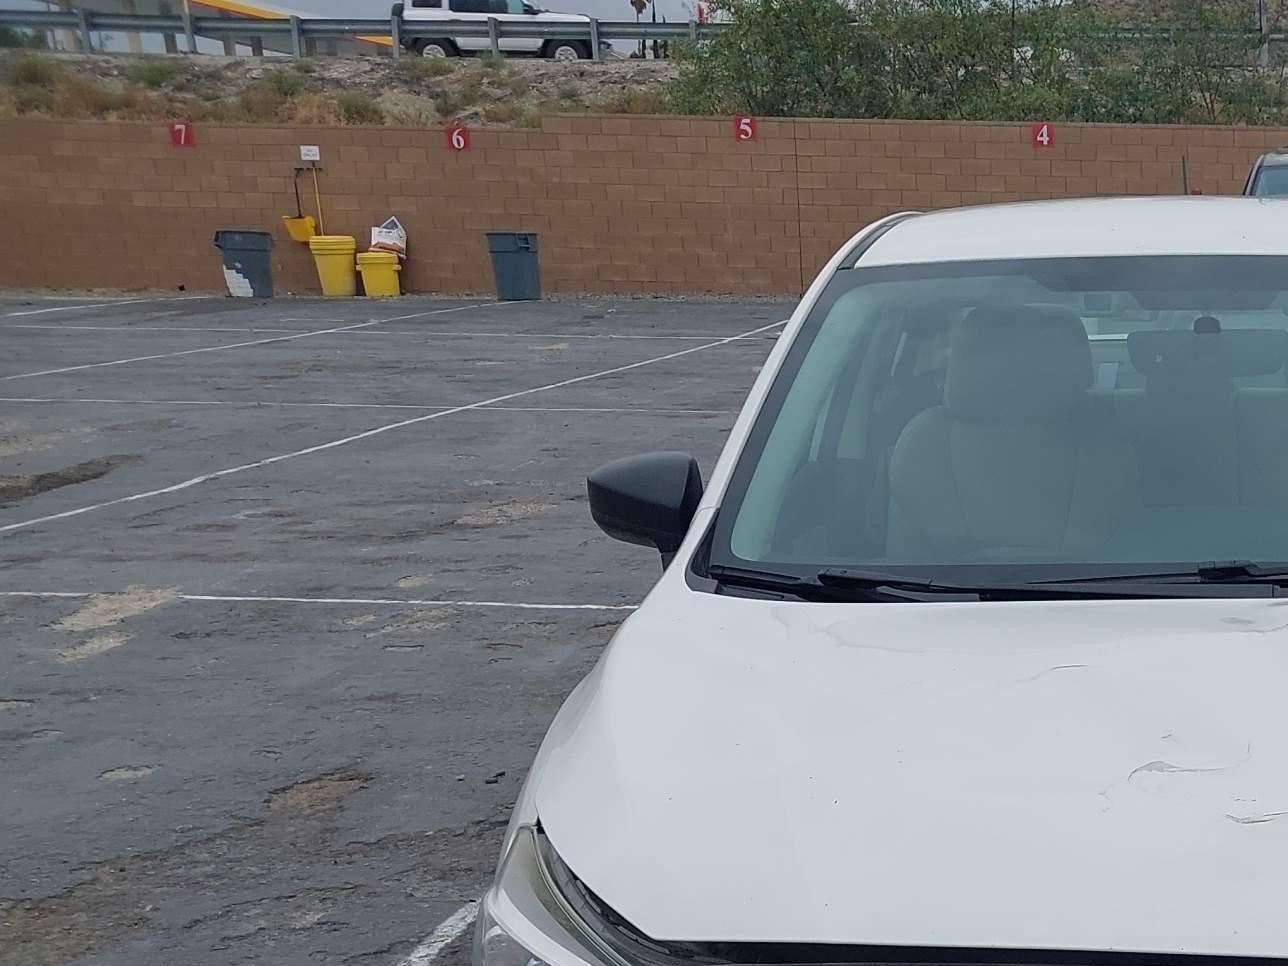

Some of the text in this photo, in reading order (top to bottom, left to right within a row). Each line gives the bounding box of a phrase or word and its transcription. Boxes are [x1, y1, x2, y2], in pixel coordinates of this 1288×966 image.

[174, 124, 186, 145] 7
[452, 128, 465, 149] 6
[739, 118, 752, 139] 5
[1036, 124, 1050, 145] 4
